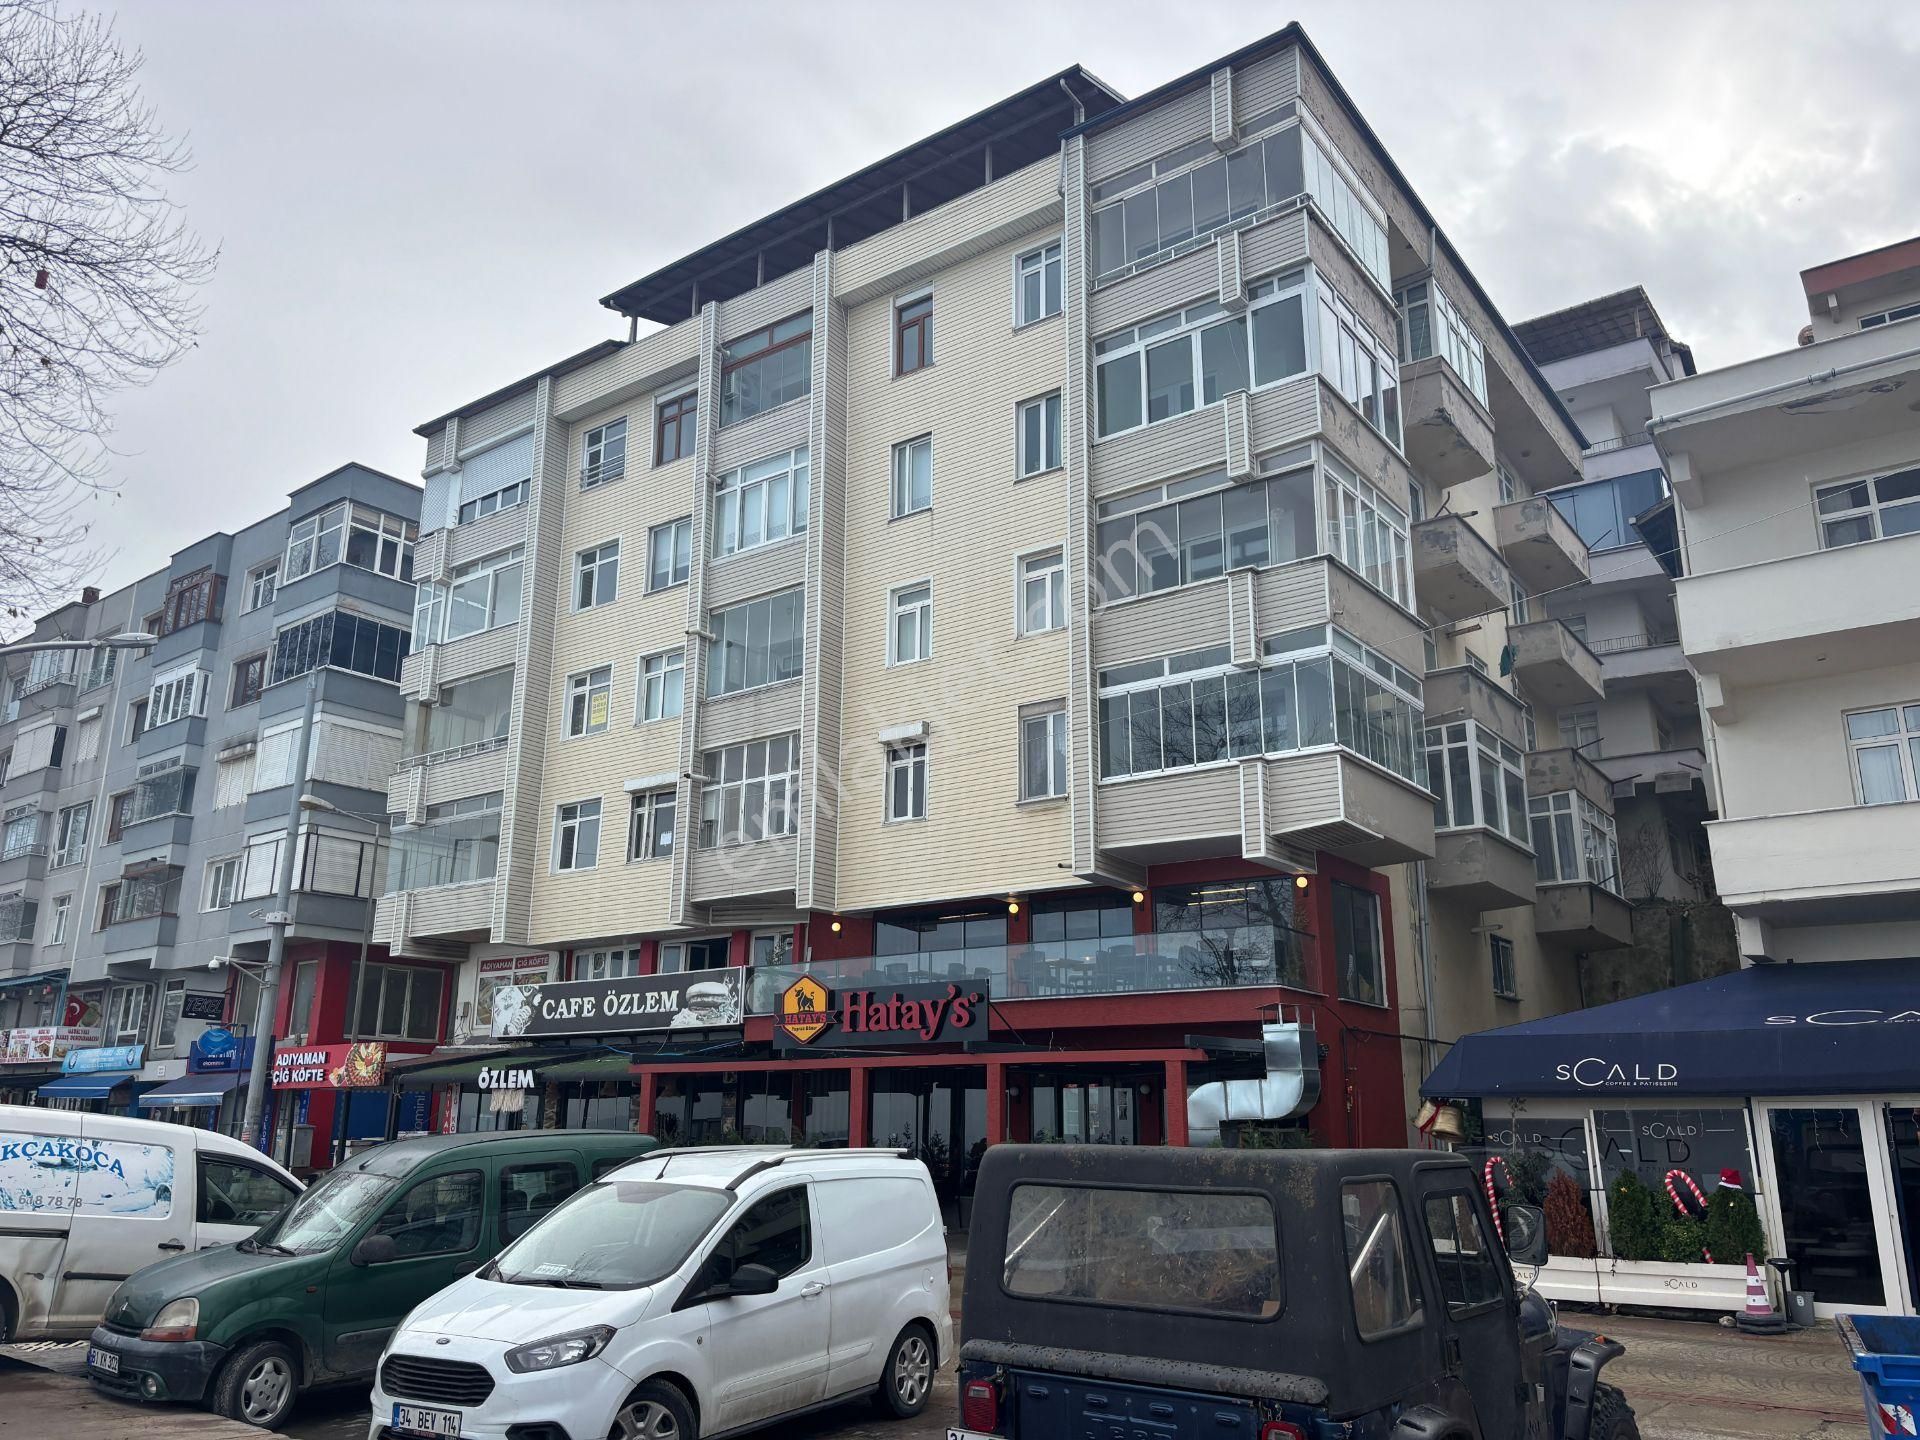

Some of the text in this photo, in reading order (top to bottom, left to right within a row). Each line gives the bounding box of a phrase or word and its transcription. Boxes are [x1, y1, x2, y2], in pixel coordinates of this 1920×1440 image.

[482, 961, 513, 970] ADIYAMAN
[185, 997, 222, 1014] TEKEL
[542, 990, 679, 1020] CAFE ÖZLEM
[840, 984, 970, 1041] Hatay's
[784, 1012, 828, 1025] HATAY'S
[276, 1052, 326, 1067] ADIYAMAN
[272, 1068, 325, 1086] ÇİĞ KÖFTE
[478, 1066, 535, 1090] ÖZLEM
[1555, 1057, 1678, 1087] SCALD
[1642, 1122, 1697, 1139] SCALD
[0, 1141, 125, 1179] KÇAKOCA
[47, 1195, 63, 1206] 78
[67, 1197, 83, 1208] 78
[1664, 1278, 1698, 1290] SCALD
[399, 1408, 412, 1427] 34
[443, 1414, 457, 1434] 114
